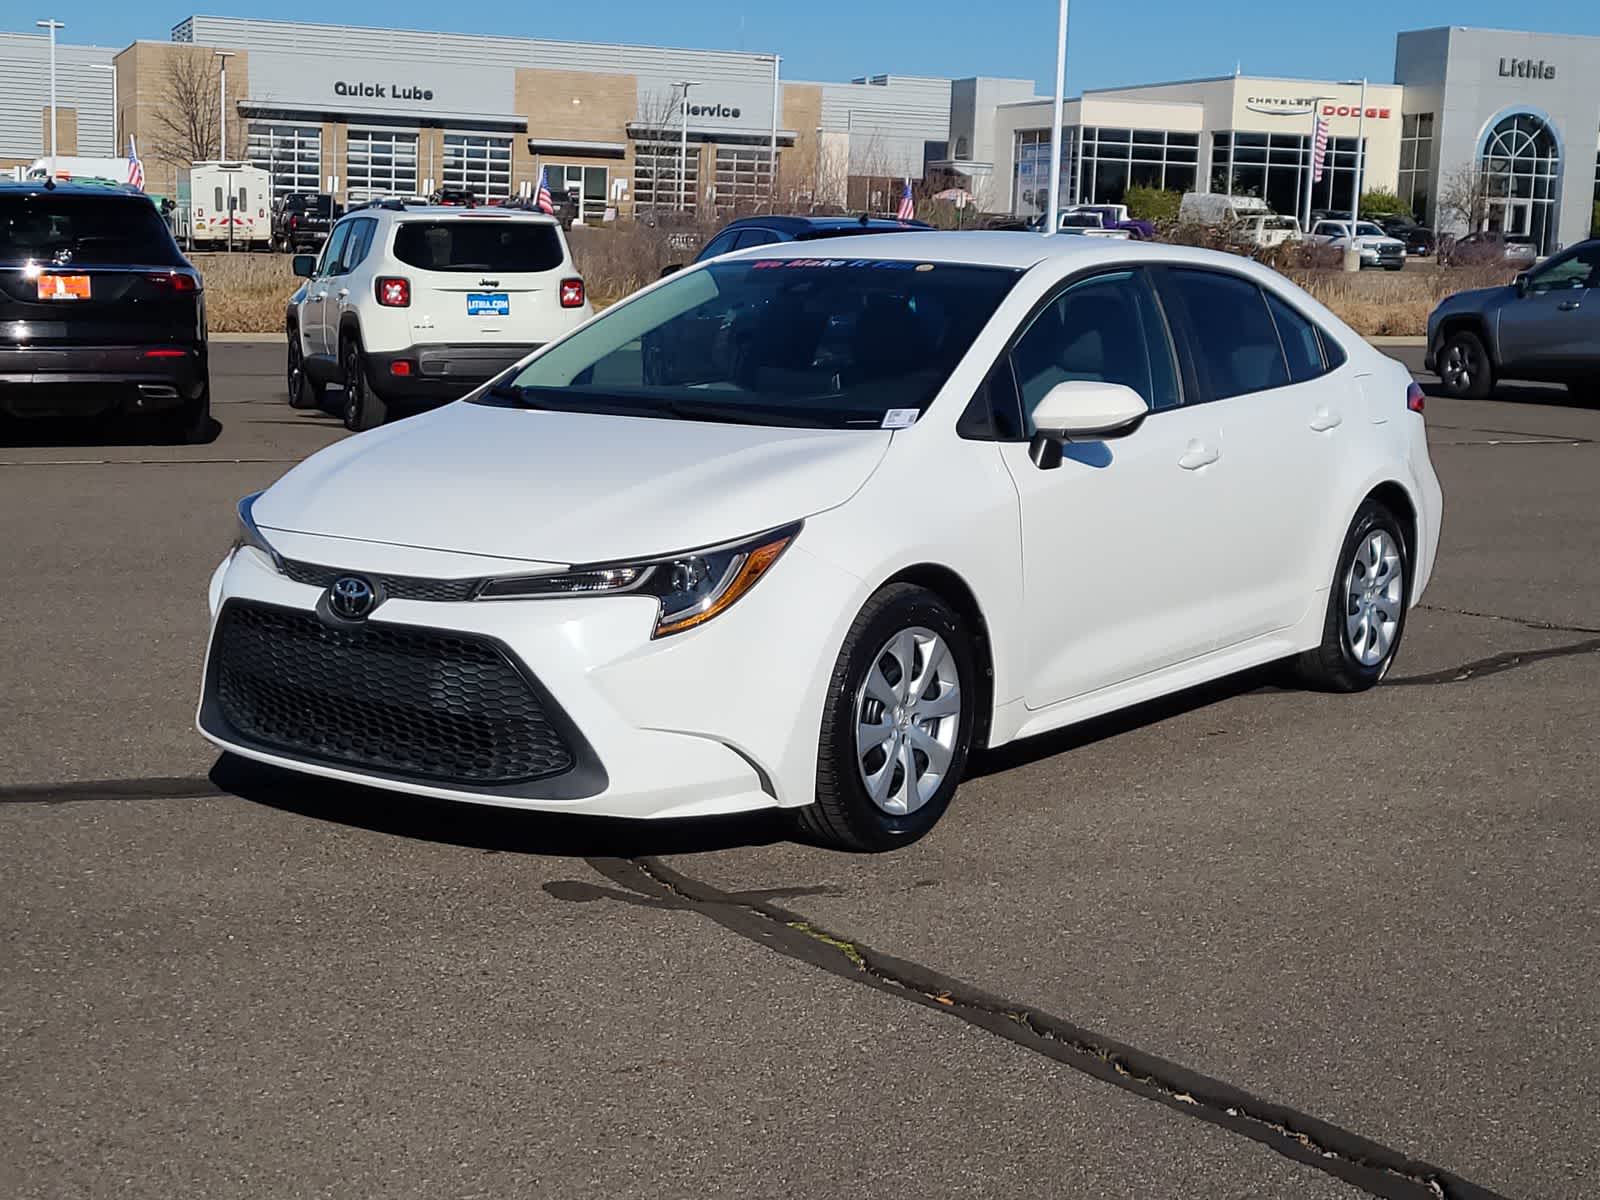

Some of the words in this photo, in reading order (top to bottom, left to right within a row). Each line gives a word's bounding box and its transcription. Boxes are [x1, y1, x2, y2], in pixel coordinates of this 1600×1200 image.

[1499, 58, 1556, 80] Lithia
[334, 81, 386, 98] Quick
[392, 84, 433, 100] Lube
[1247, 96, 1313, 106] CHRYSLER
[1322, 105, 1391, 118] DODGE
[479, 279, 500, 288] Jeep
